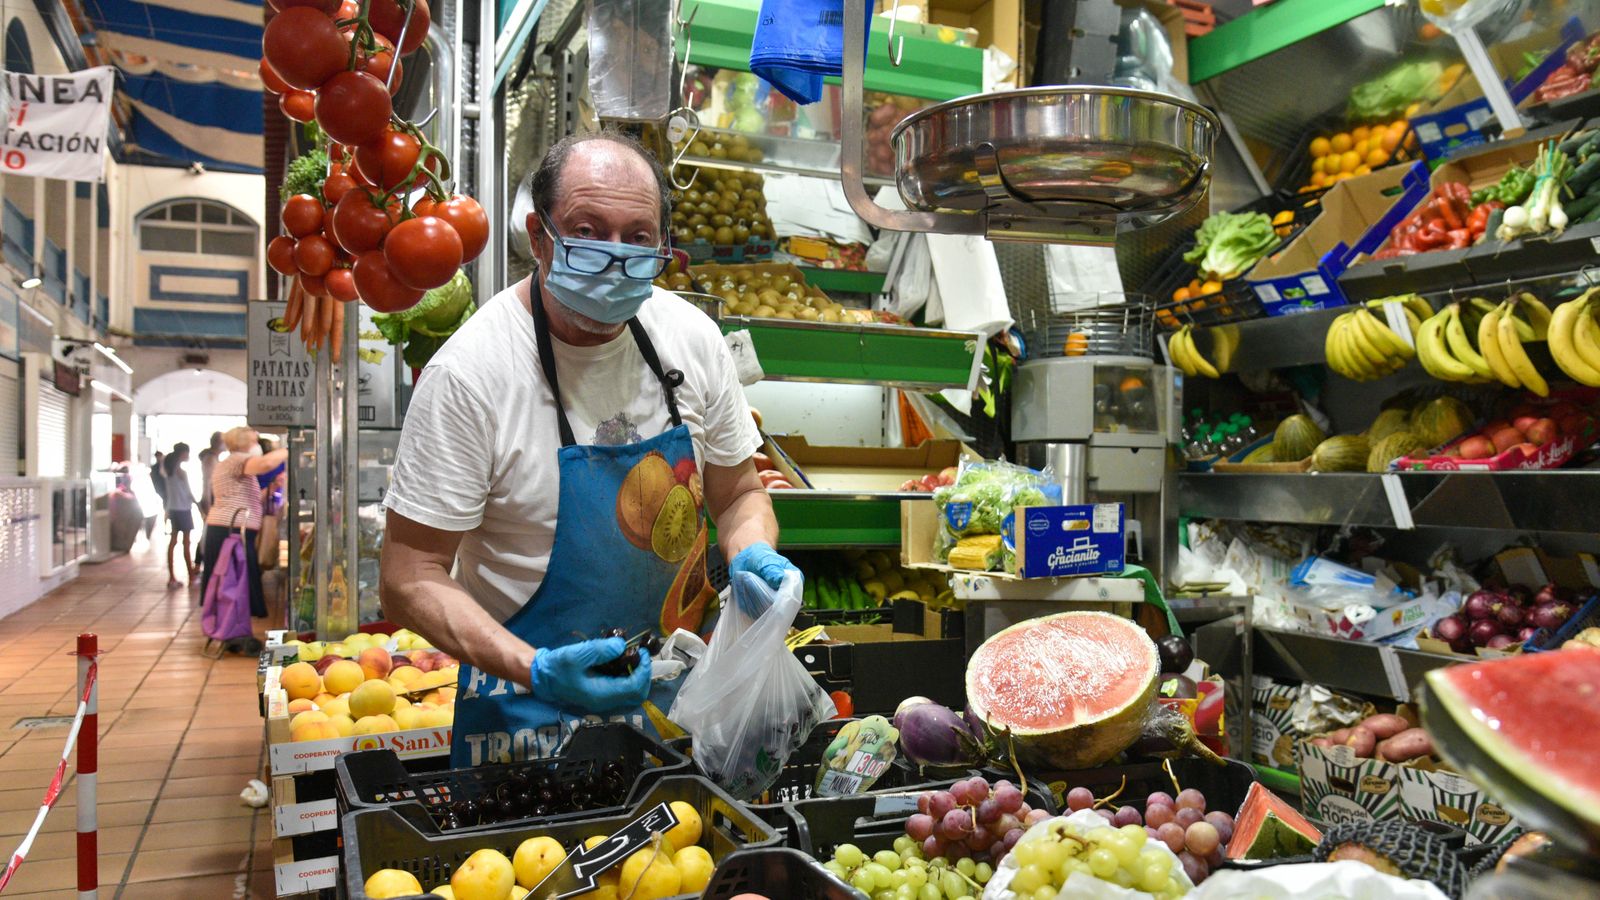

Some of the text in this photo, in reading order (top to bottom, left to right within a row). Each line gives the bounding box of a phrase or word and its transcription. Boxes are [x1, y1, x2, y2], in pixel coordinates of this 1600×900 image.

[253, 360, 309, 378] PATATAS
[257, 380, 305, 397] FRITAS
[266, 403, 304, 413] cartuchos
[1047, 548, 1101, 570] Gracianito
[391, 735, 430, 753] San
[294, 749, 341, 760] COOPERATIVA
